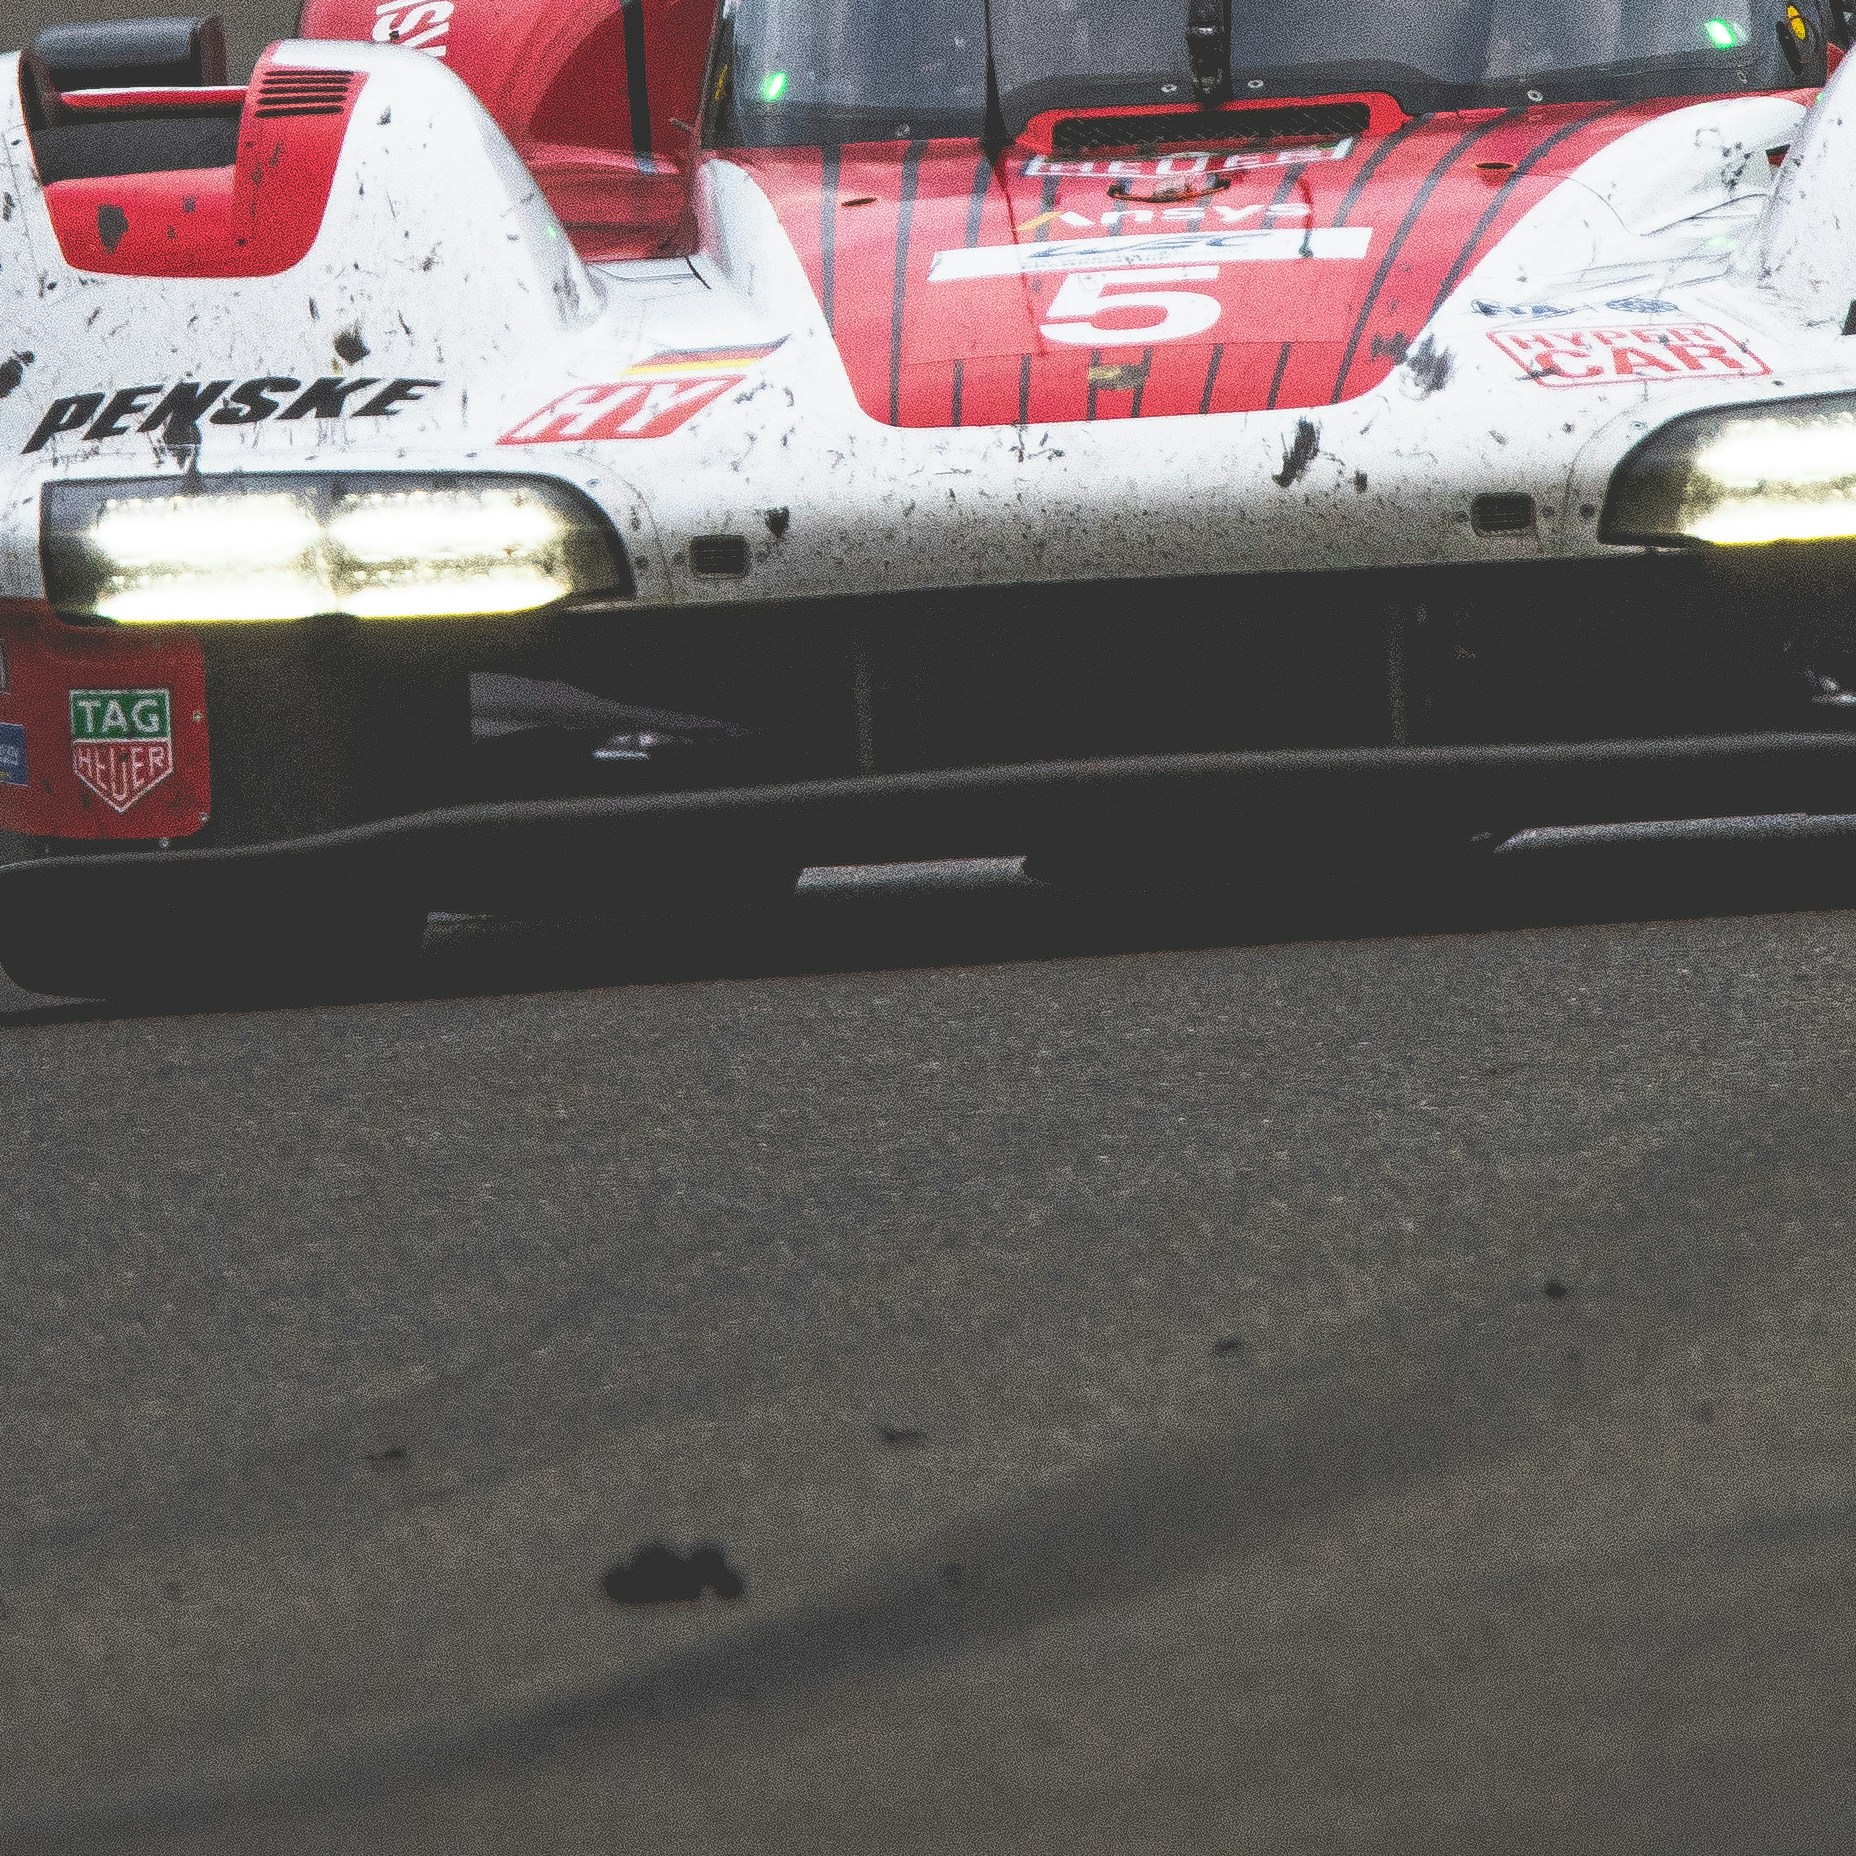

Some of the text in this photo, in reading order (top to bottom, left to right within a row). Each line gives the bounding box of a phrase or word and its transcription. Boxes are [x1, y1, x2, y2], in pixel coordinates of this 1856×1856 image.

[1017, 202, 1310, 231] Ansys
[1039, 266, 1223, 345] 5
[1507, 328, 1715, 350] HYPER
[1535, 344, 1745, 377] CAR
[21, 376, 444, 455] PENSKE
[510, 378, 736, 439] HY
[78, 698, 161, 734] TAG
[78, 745, 165, 801] HEUER
